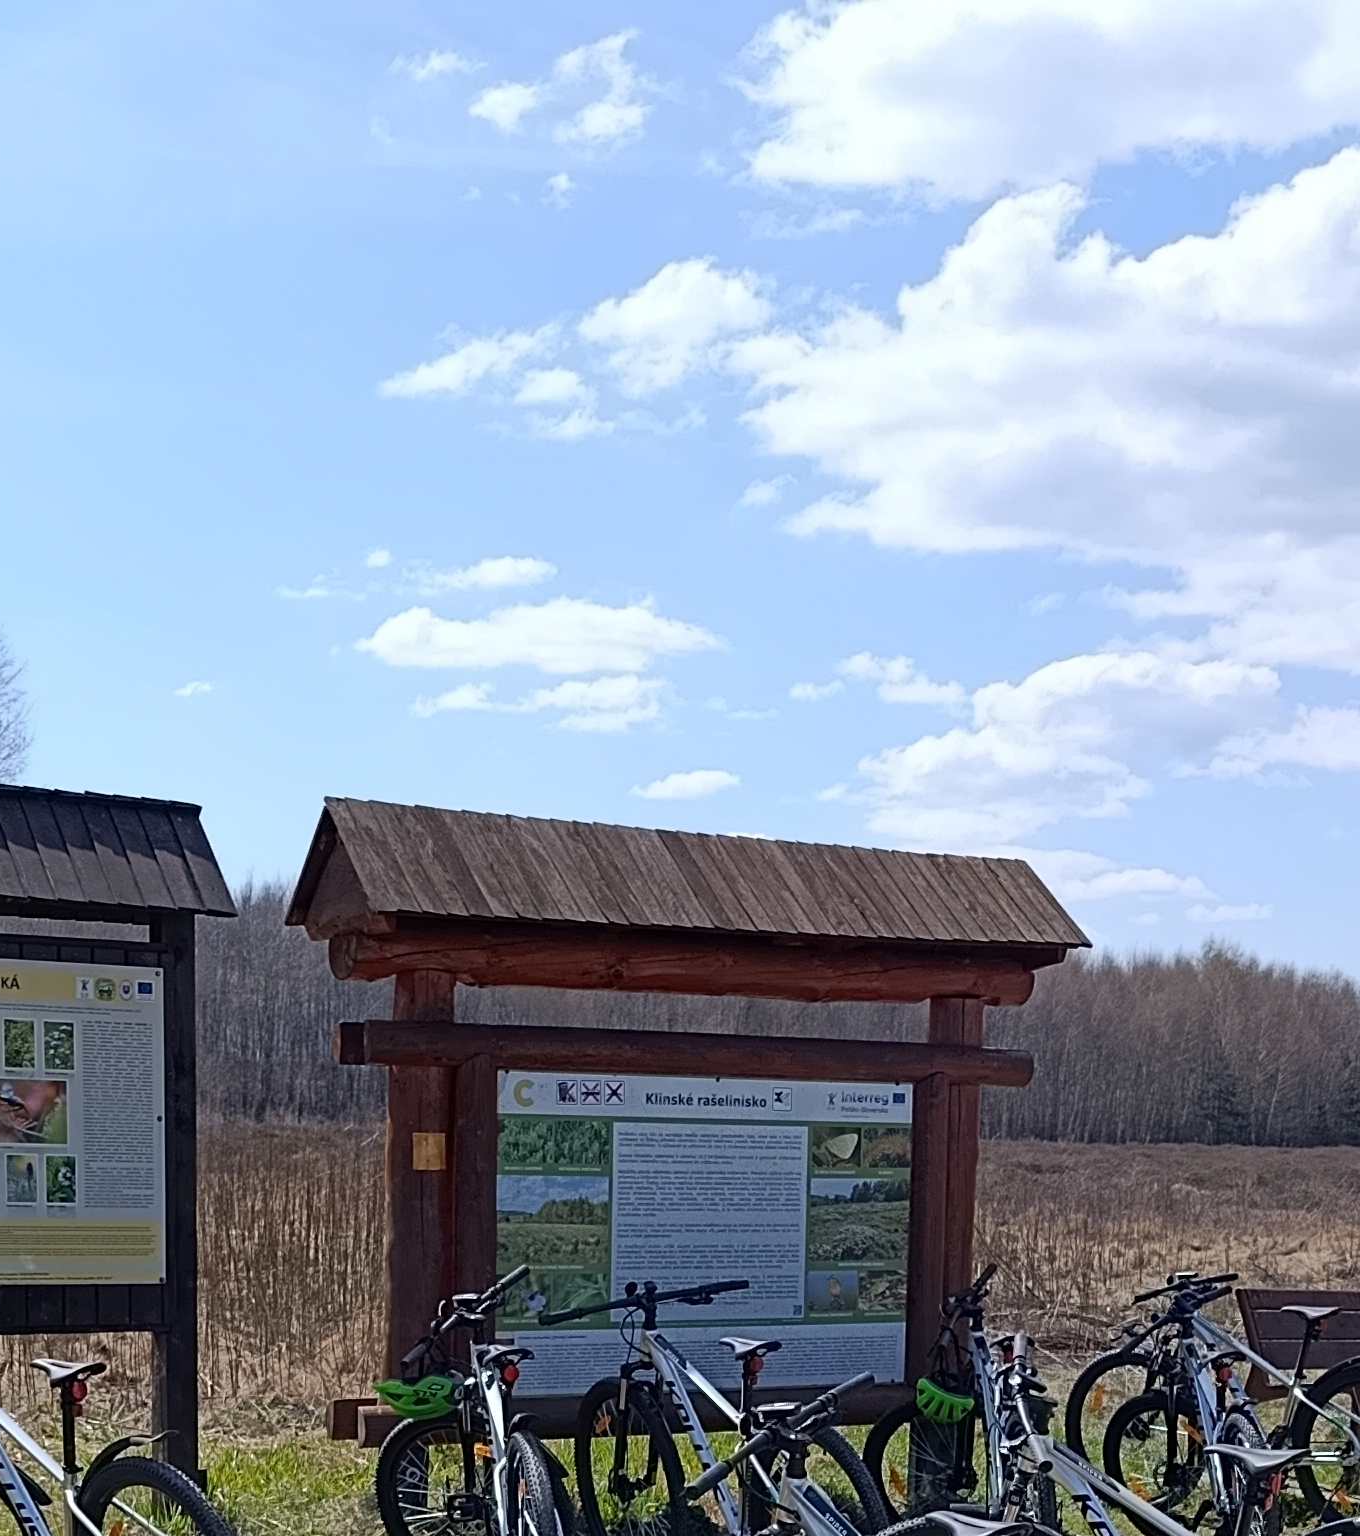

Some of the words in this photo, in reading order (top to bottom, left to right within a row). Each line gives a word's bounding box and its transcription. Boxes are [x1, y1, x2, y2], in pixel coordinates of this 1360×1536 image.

[645, 1090, 694, 1107] Klinské
[697, 1093, 767, 1109] rašelinisko
[824, 1512, 848, 1536] SPIDER
